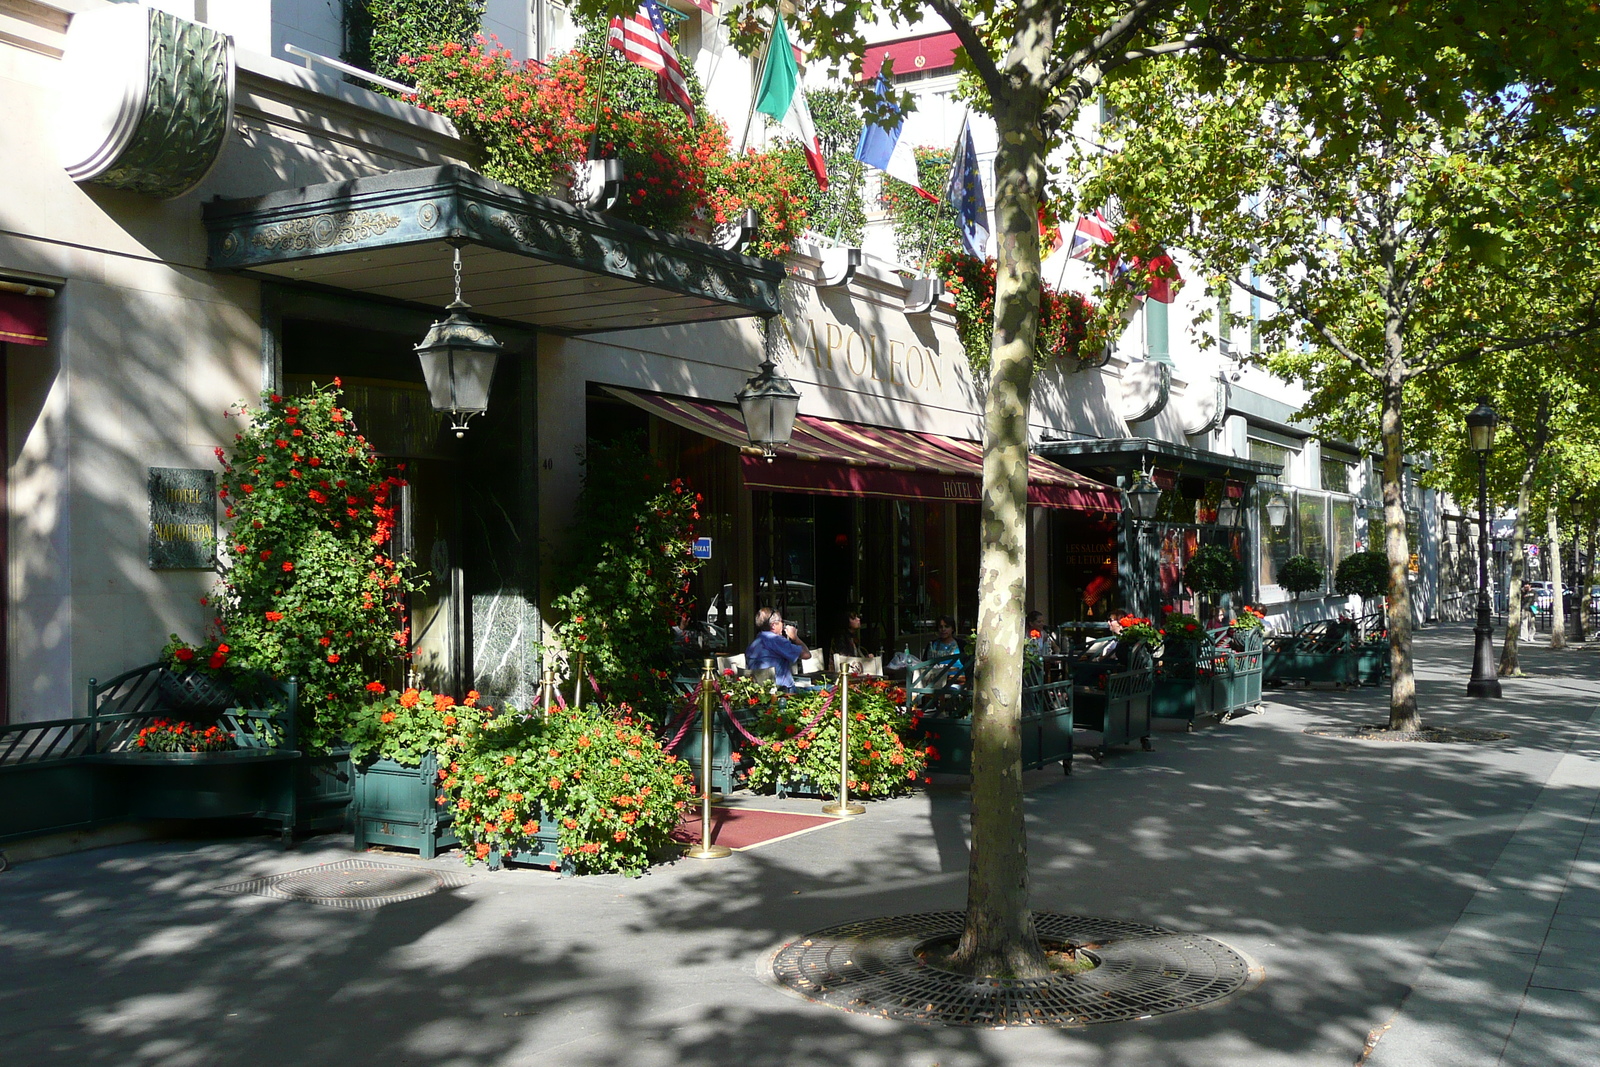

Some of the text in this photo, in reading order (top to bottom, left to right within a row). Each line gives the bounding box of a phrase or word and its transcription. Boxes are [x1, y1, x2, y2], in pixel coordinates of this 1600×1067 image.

[777, 313, 943, 391] NAPOLEON
[542, 457, 553, 470] 40
[166, 488, 202, 503] HOTEL
[155, 523, 212, 542] NAPOLEON
[1066, 543, 1112, 553] LES SALONS
[1066, 554, 1076, 565] DE
